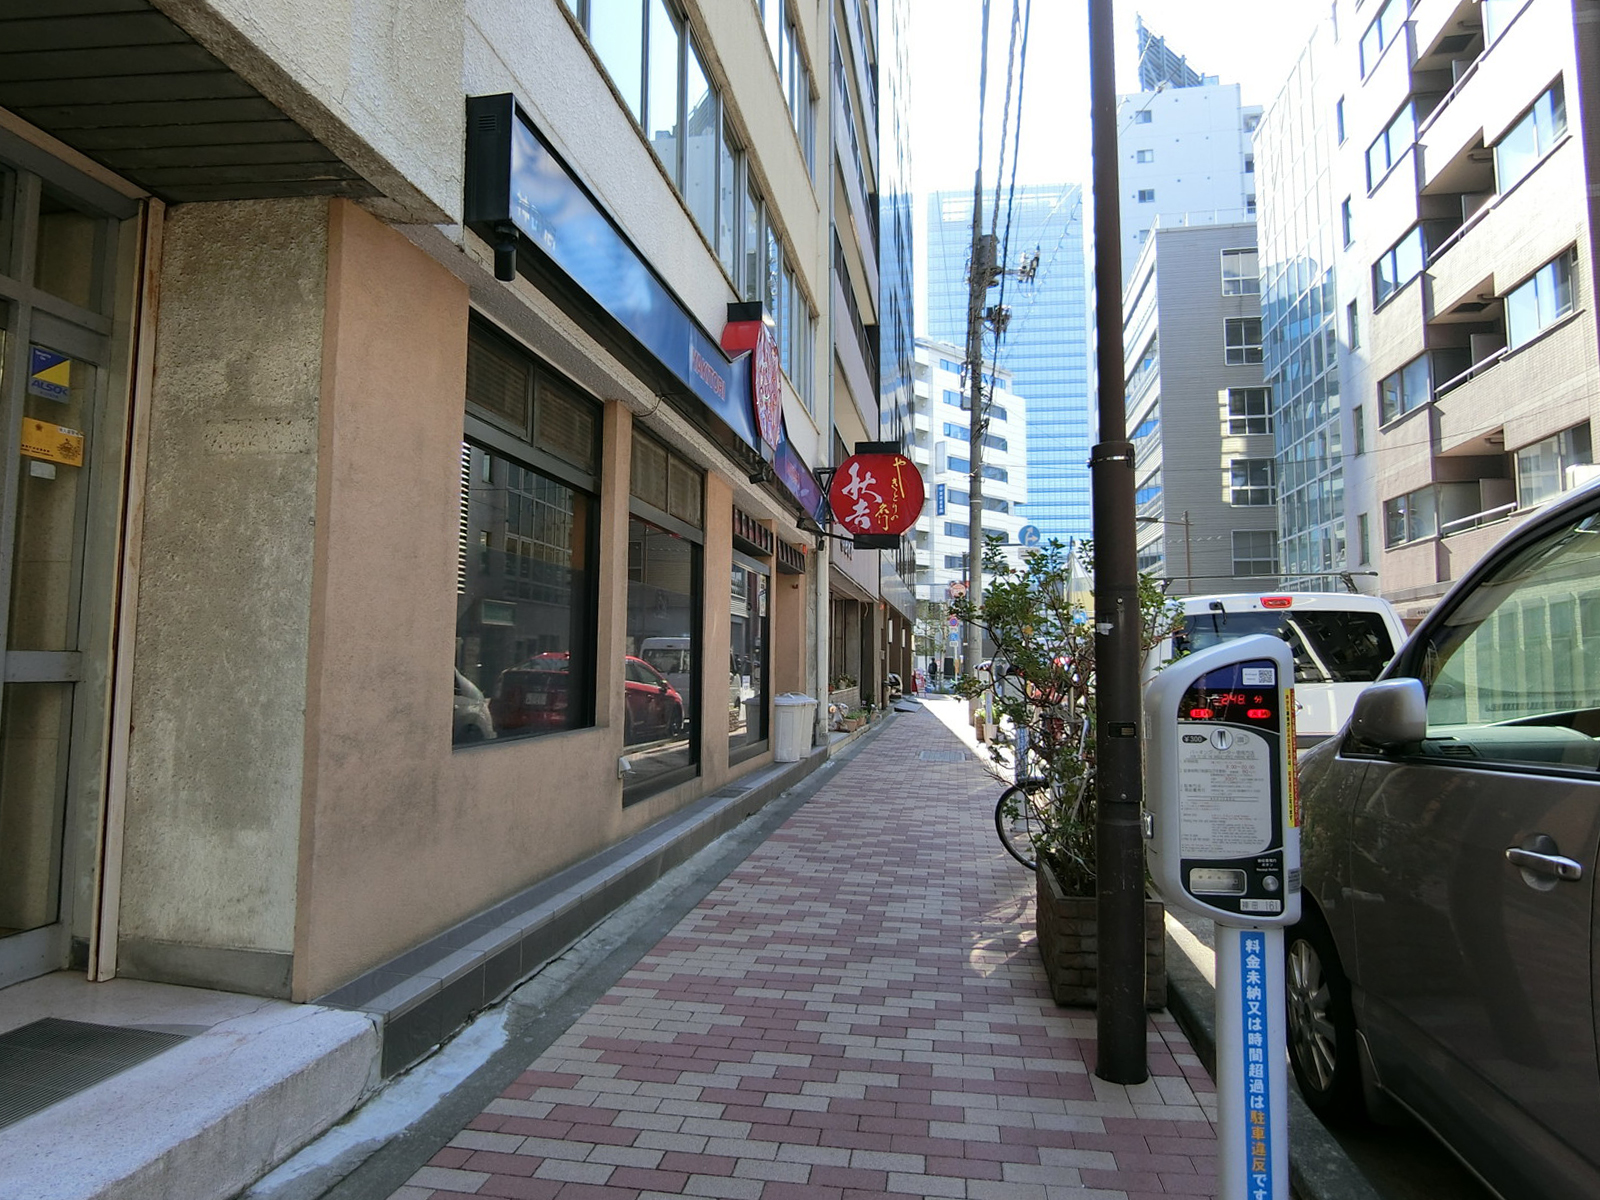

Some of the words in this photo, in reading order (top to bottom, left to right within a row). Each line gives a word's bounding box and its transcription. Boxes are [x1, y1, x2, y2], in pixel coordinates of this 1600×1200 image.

[31, 378, 68, 396] ALSOK
[842, 461, 883, 530] 秋吉
[1244, 939, 1268, 1200] 料金未納又は時間超過は駐車違反です
